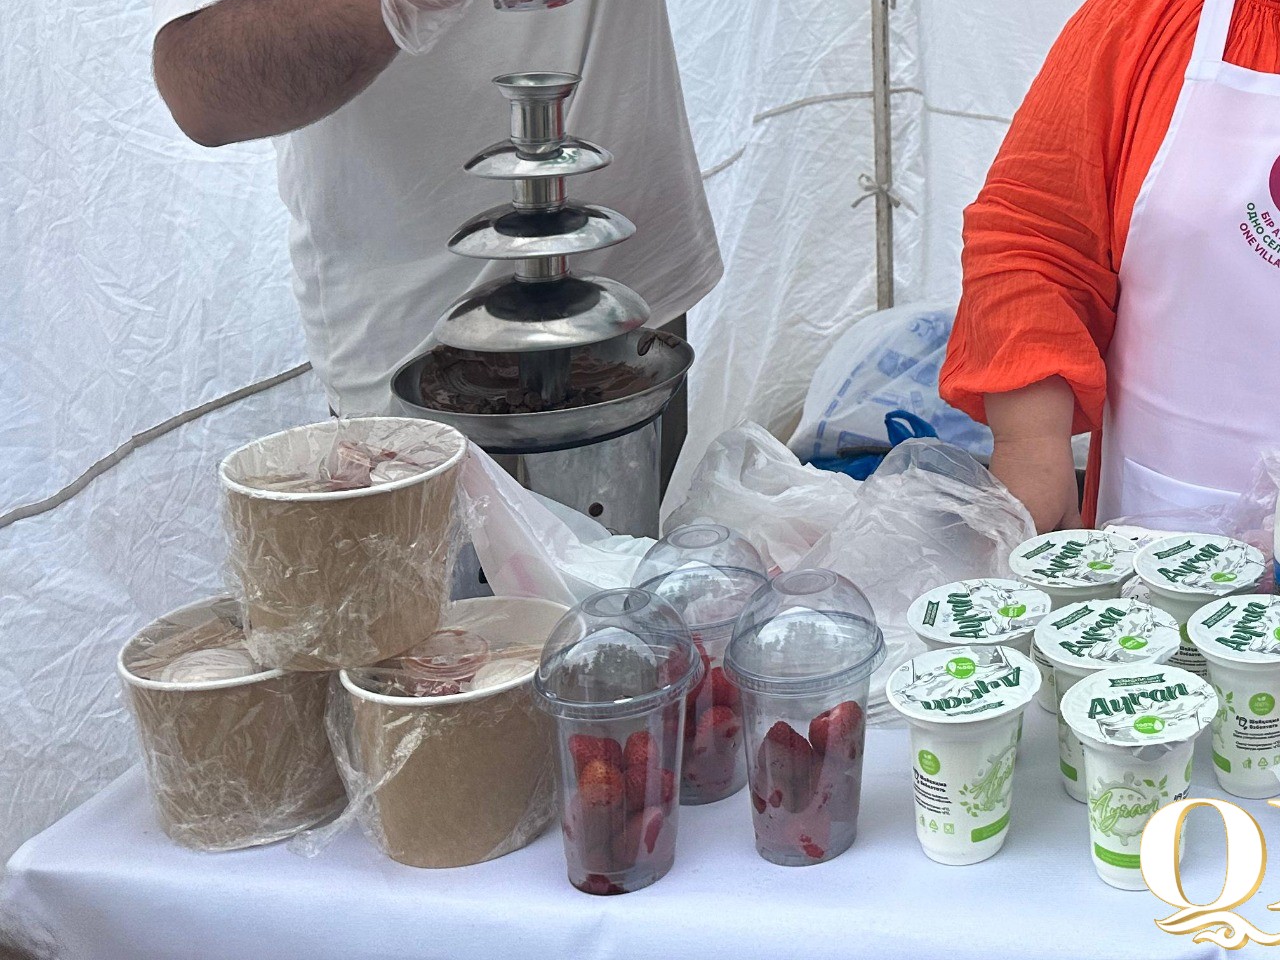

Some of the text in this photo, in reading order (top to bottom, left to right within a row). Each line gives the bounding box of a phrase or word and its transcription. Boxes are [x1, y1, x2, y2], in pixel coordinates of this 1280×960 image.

[1240, 223, 1257, 246] ONE
[1247, 202, 1265, 235] ОДНО
[1261, 211, 1274, 228] БІР
[1059, 607, 1126, 657] Ayran
[1215, 602, 1269, 652] Ayran
[920, 667, 1021, 711] Ayran
[1088, 683, 1189, 719] Ayran
[1090, 791, 1159, 832] Ayran
